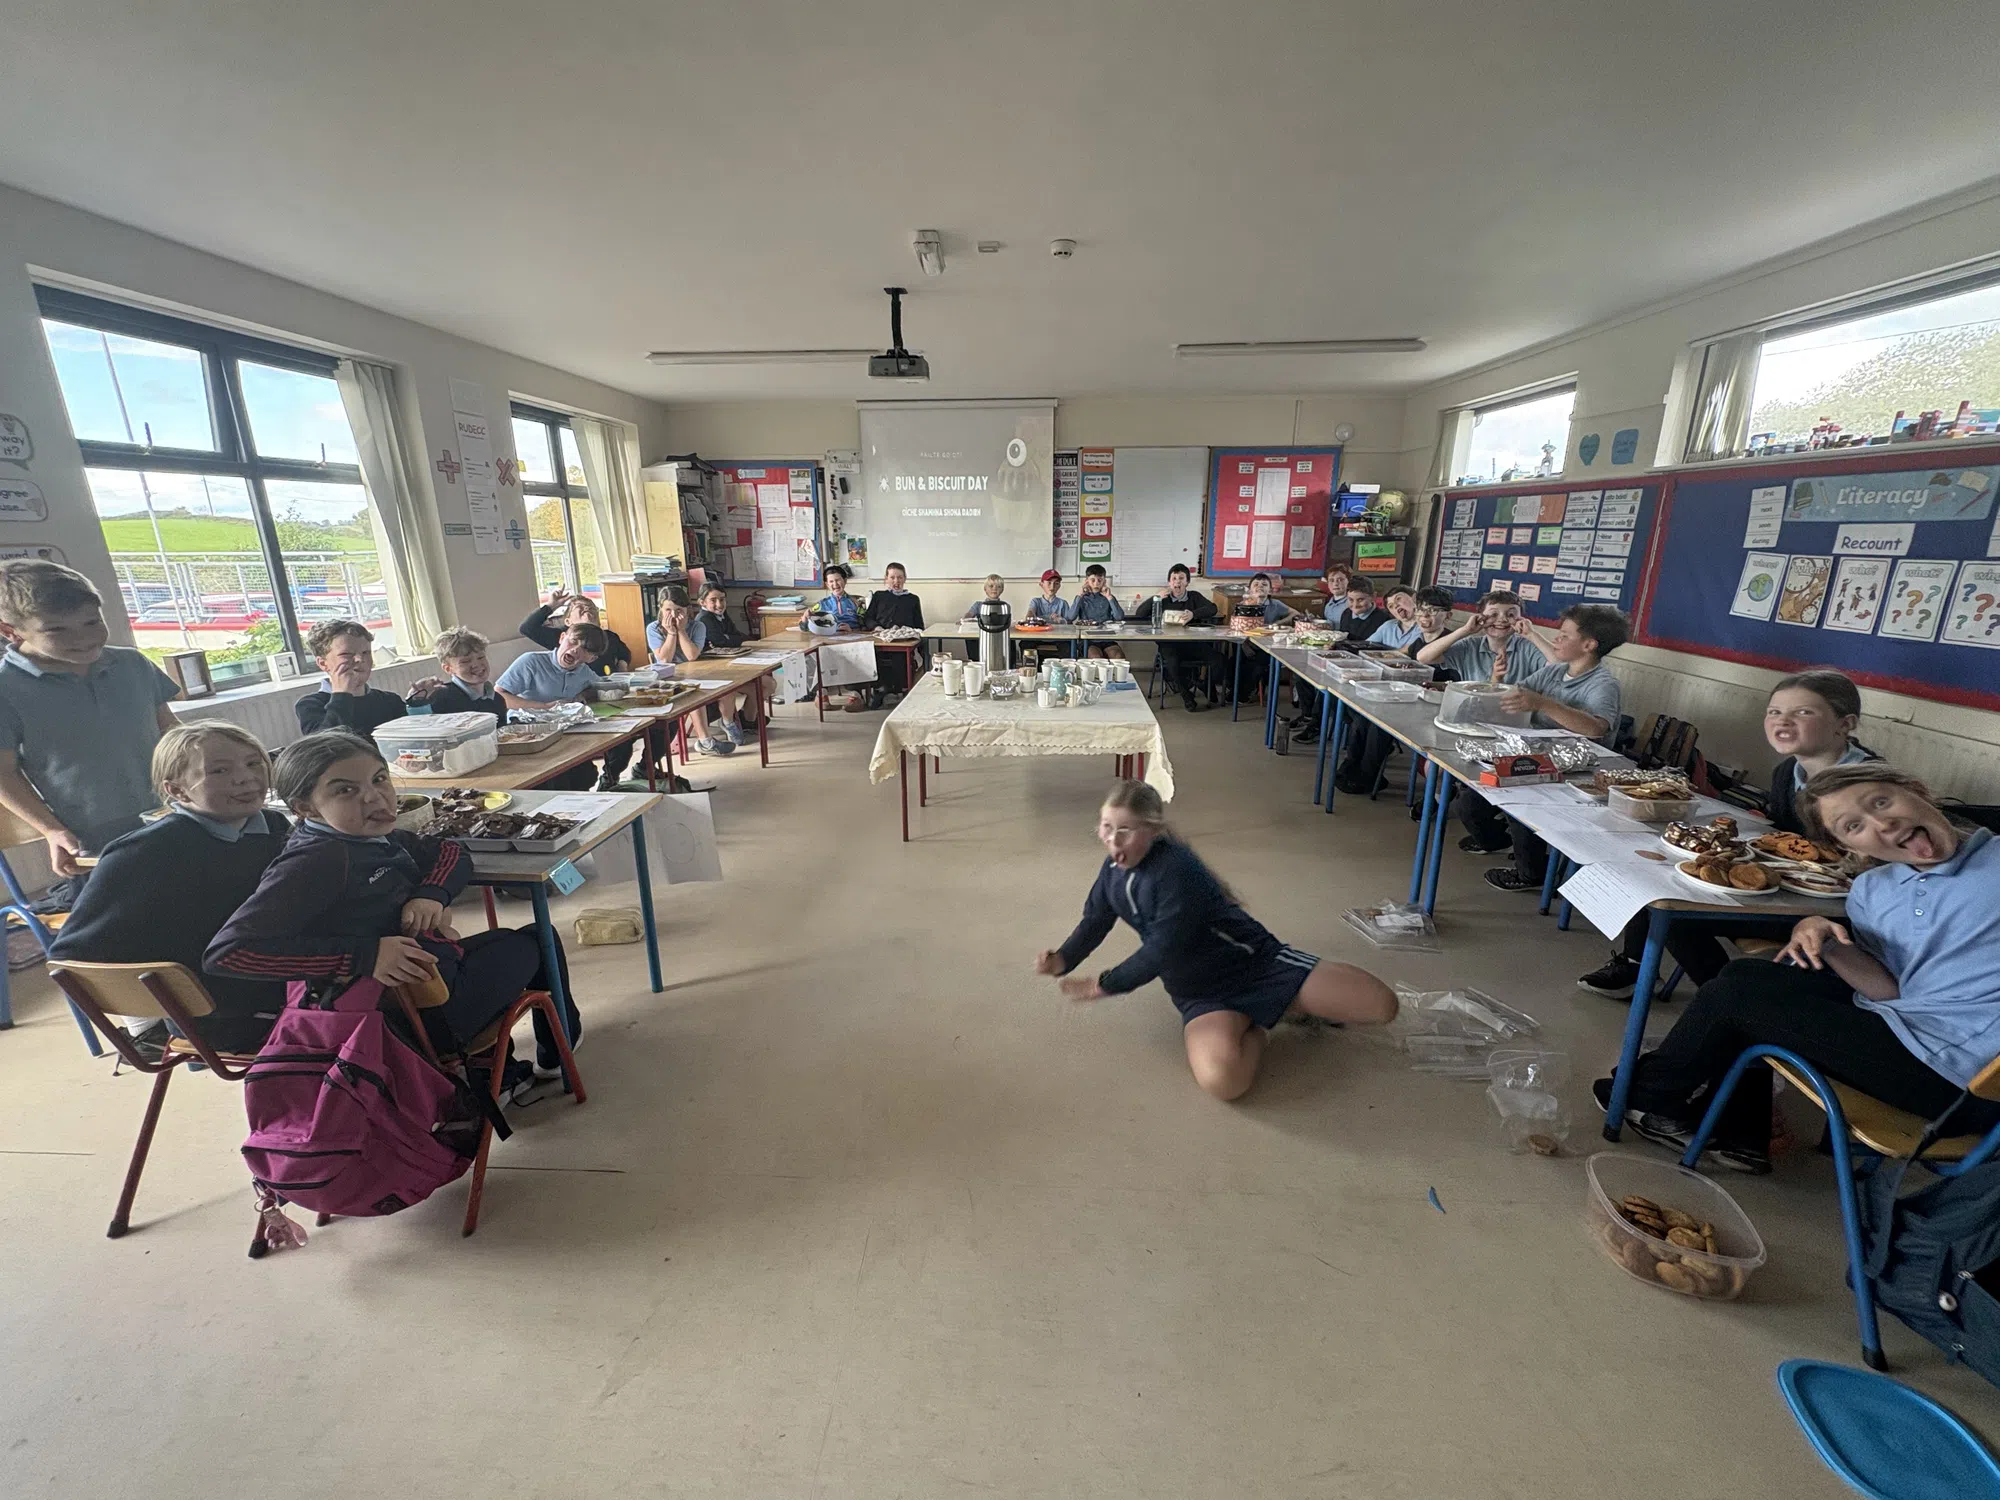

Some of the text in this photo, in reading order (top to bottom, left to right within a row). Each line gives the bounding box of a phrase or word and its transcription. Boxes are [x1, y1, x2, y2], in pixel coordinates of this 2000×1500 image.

[1053, 457, 1076, 466] CHEDULE
[895, 475, 988, 491] BUN & BISCUIT DAY
[0, 489, 29, 499] gree
[1762, 490, 1775, 499] first
[1836, 486, 1930, 509] Literacy
[1840, 535, 1903, 551] Recount
[1361, 545, 1384, 555] Be safe
[1848, 563, 1880, 577] who?
[1904, 566, 1945, 579] what?
